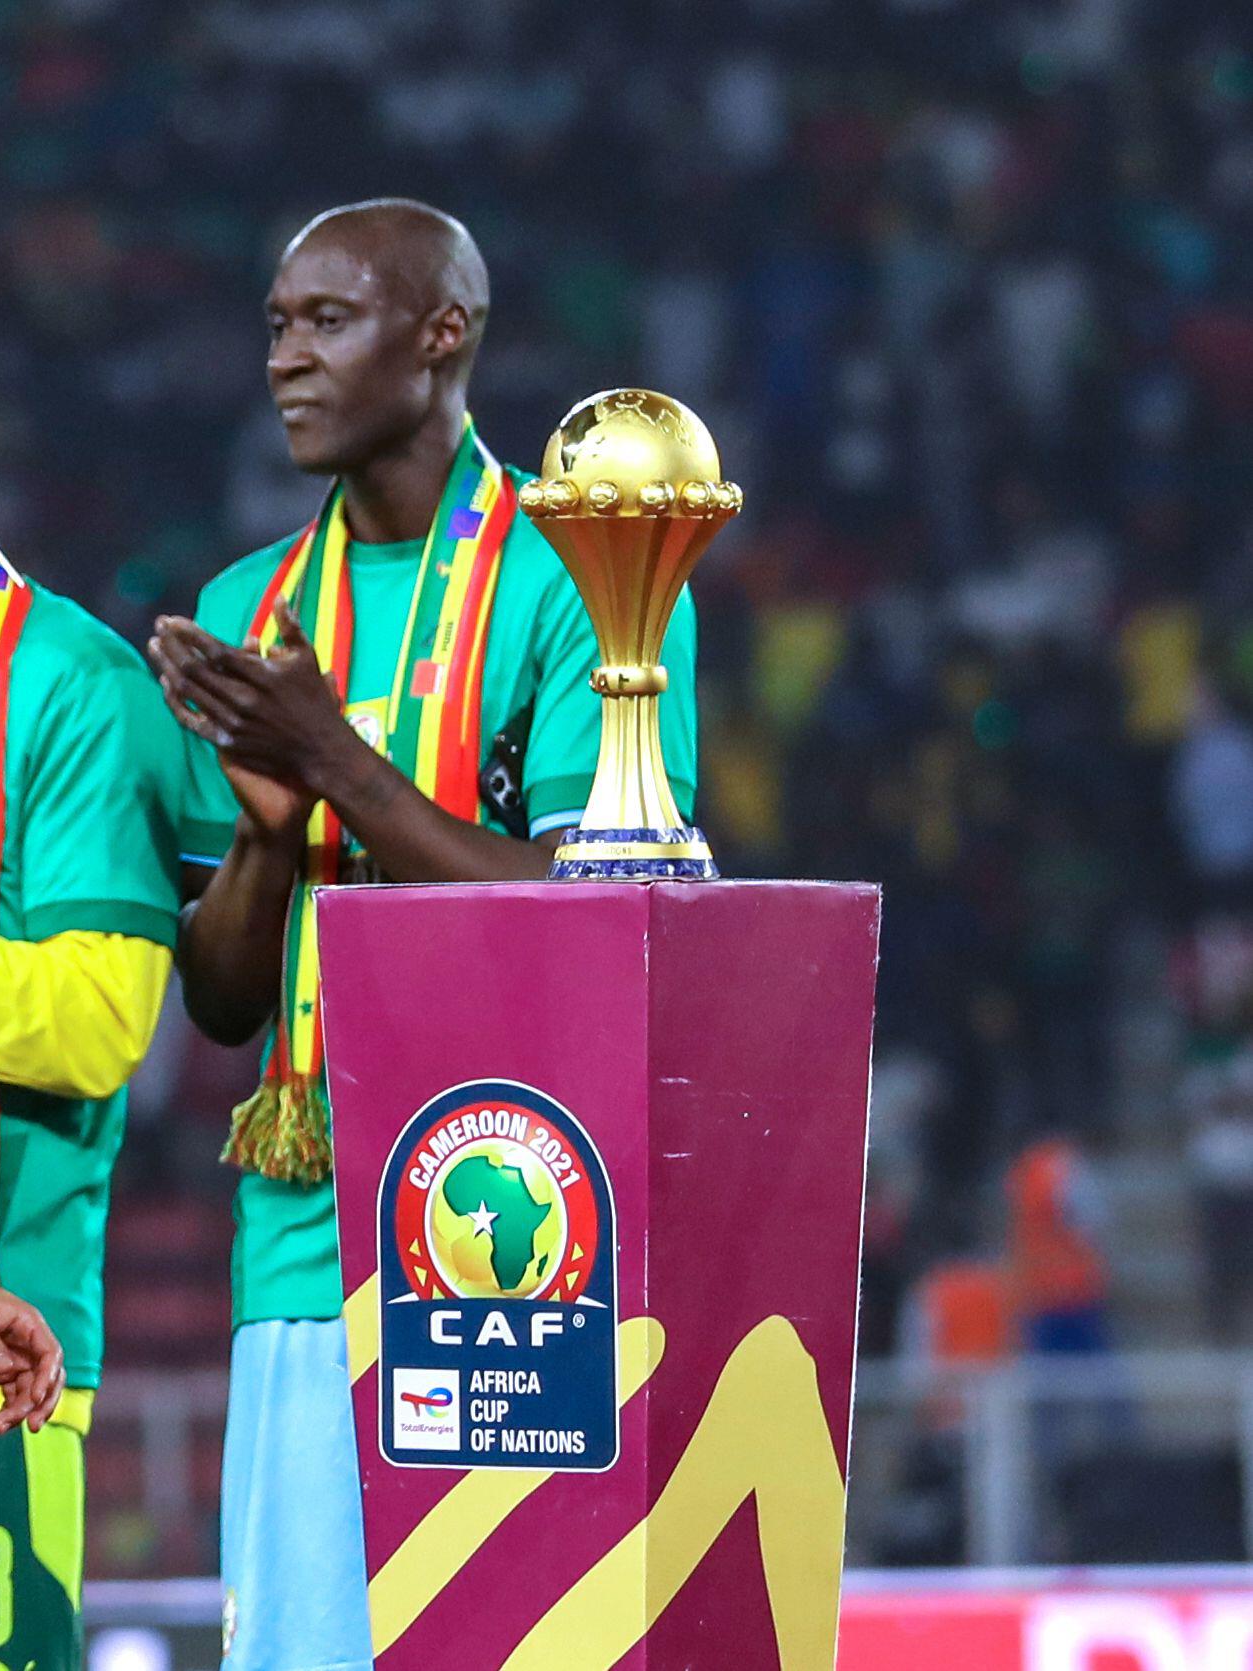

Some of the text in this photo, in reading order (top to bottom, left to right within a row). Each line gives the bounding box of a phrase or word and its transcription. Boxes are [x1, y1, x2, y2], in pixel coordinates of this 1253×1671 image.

[409, 1109, 582, 1190] CAMEROON 2021
[429, 1310, 564, 1347] CAF
[469, 1370, 541, 1395] AFRICA
[469, 1400, 509, 1423] CUP
[400, 1423, 455, 1434] TotalEnergies
[470, 1429, 586, 1455] OF NATIONS
